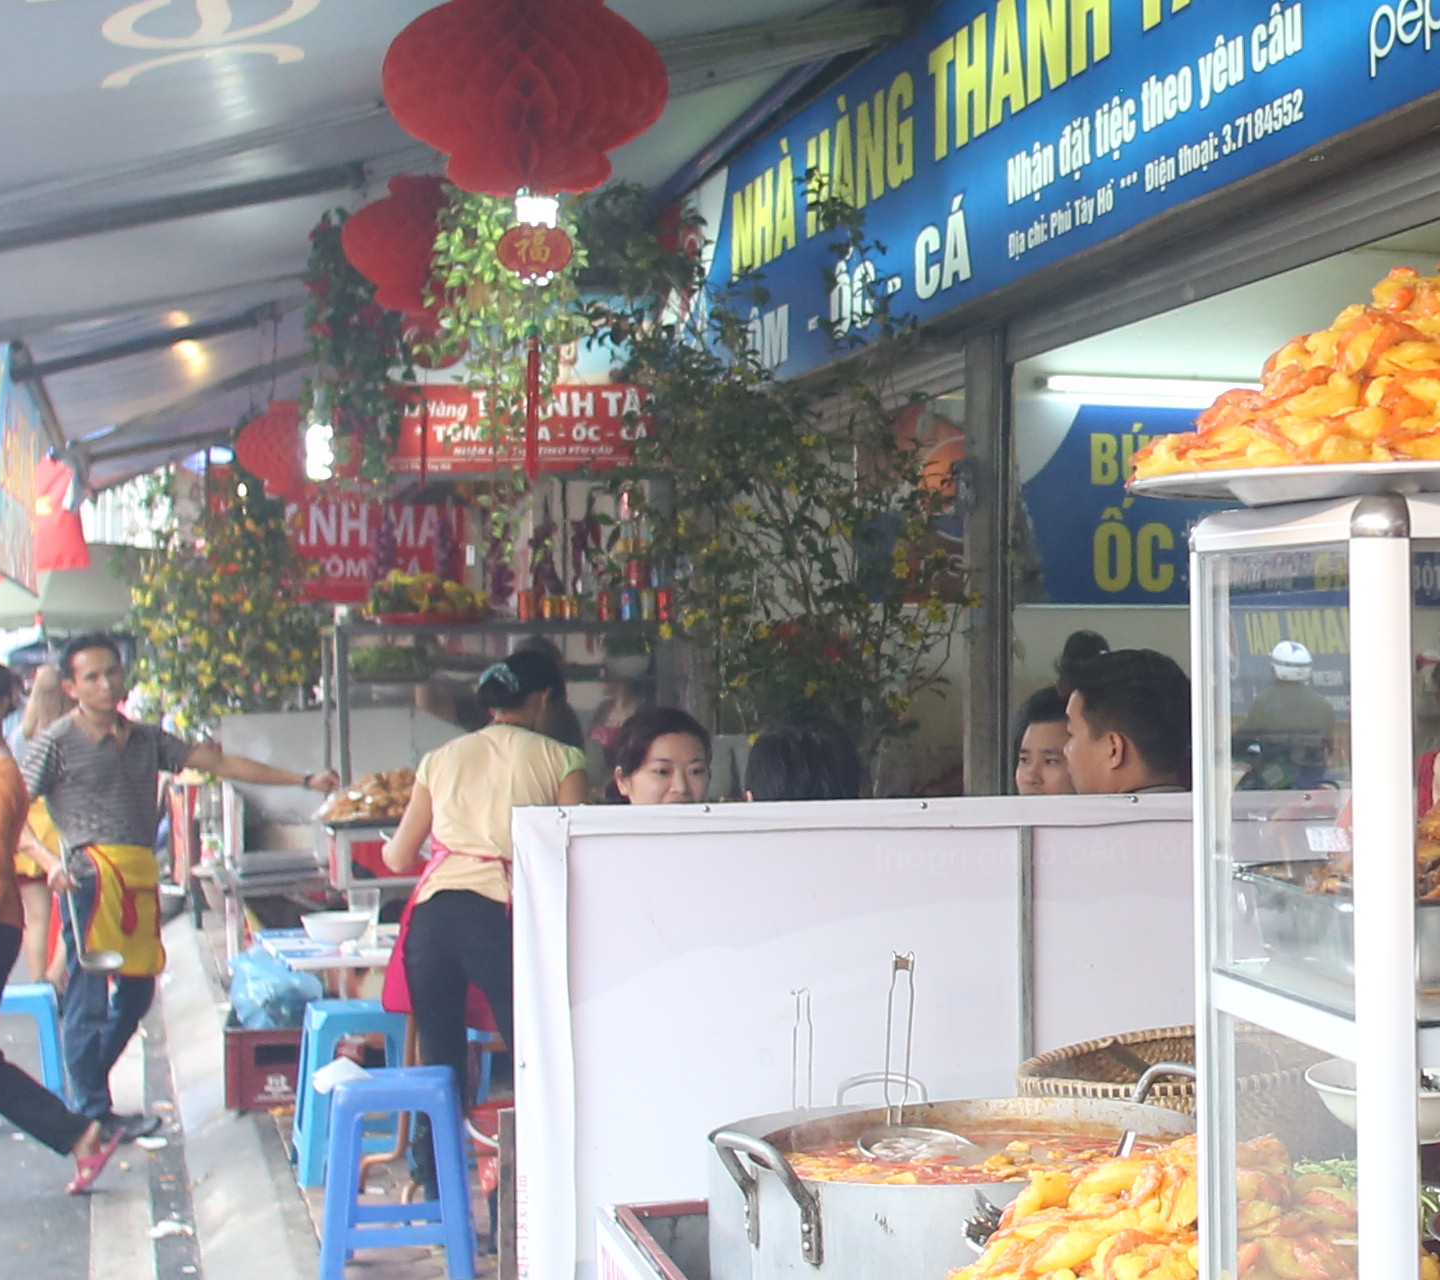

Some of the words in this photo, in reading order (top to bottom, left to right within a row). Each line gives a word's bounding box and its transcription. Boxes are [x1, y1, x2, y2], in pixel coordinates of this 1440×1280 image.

[1007, 148, 1056, 204] Nhận
[1058, 115, 1093, 182] đặt
[1095, 96, 1137, 162] tiệc
[1140, 65, 1193, 126] theo
[1196, 33, 1246, 110] yêu
[1222, 88, 1306, 156] 3.7184552
[730, 138, 797, 282] NHÀ
[805, 80, 915, 240] HÀNG
[914, 193, 972, 302] CÁ
[1090, 422, 1160, 486] BÚ
[1093, 501, 1176, 593] ỐC
